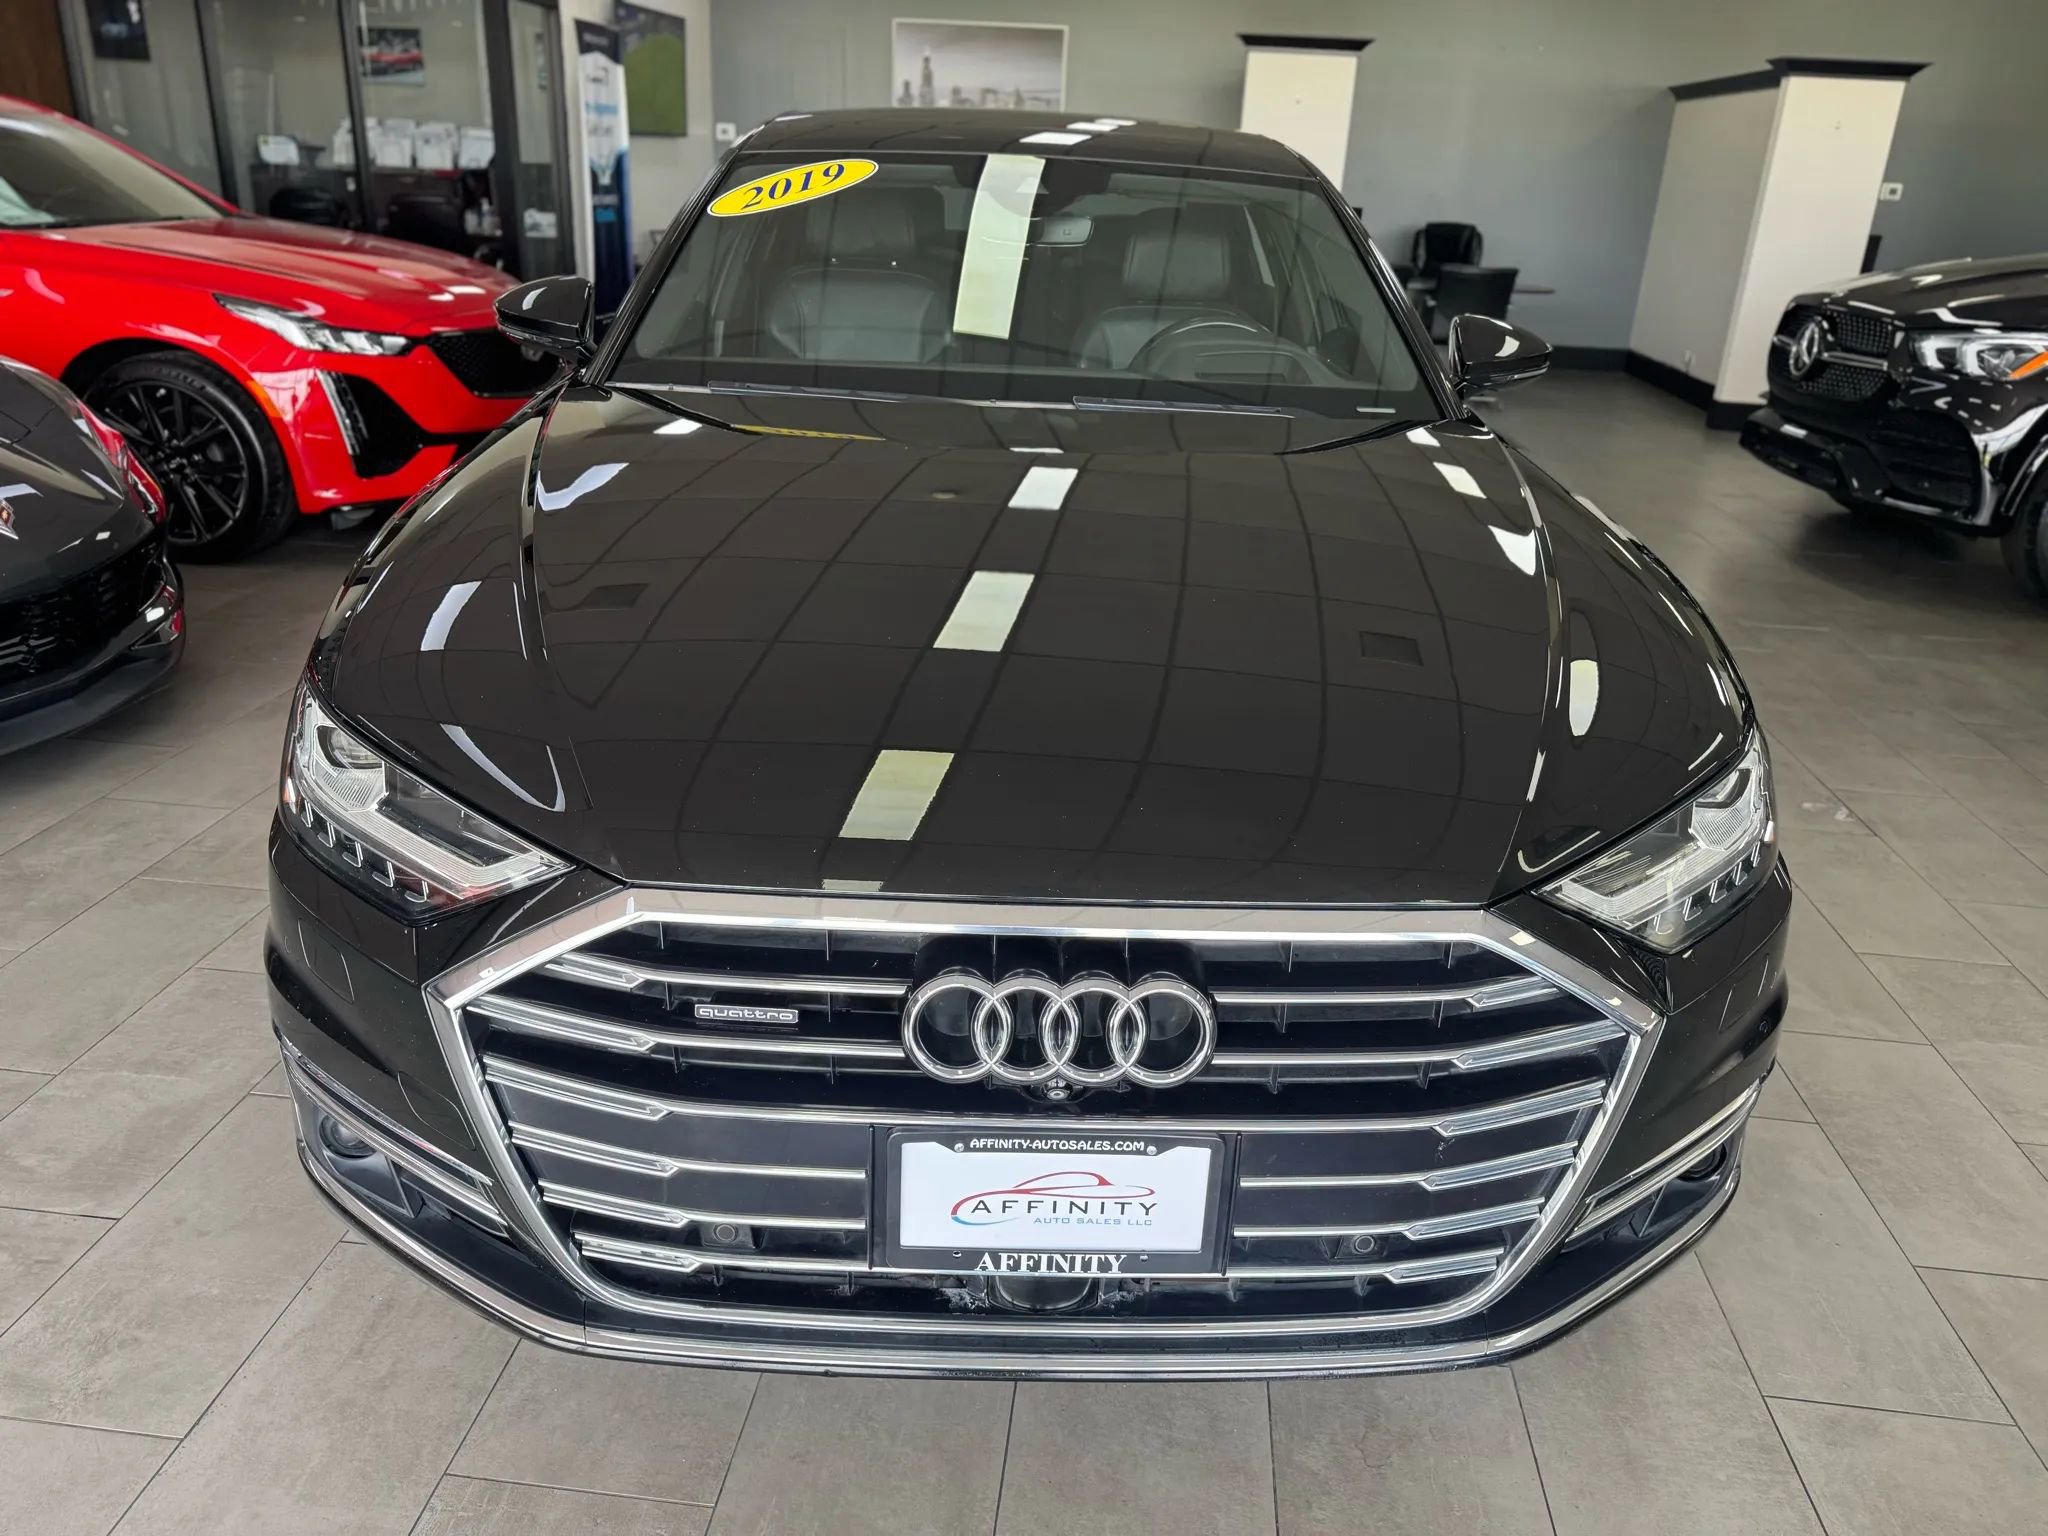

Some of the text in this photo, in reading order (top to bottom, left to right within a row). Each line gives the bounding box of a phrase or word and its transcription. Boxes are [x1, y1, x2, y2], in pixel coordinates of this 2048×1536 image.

[740, 163, 845, 210] 2019
[699, 1008, 793, 1020] quattro
[969, 1138, 1145, 1151] AFFINITY-AUTOSALES.COM
[970, 1199, 1158, 1216] AFFINITY
[1033, 1216, 1153, 1226] AUTO SALES LLC
[973, 1252, 1128, 1274] AFFINITY
